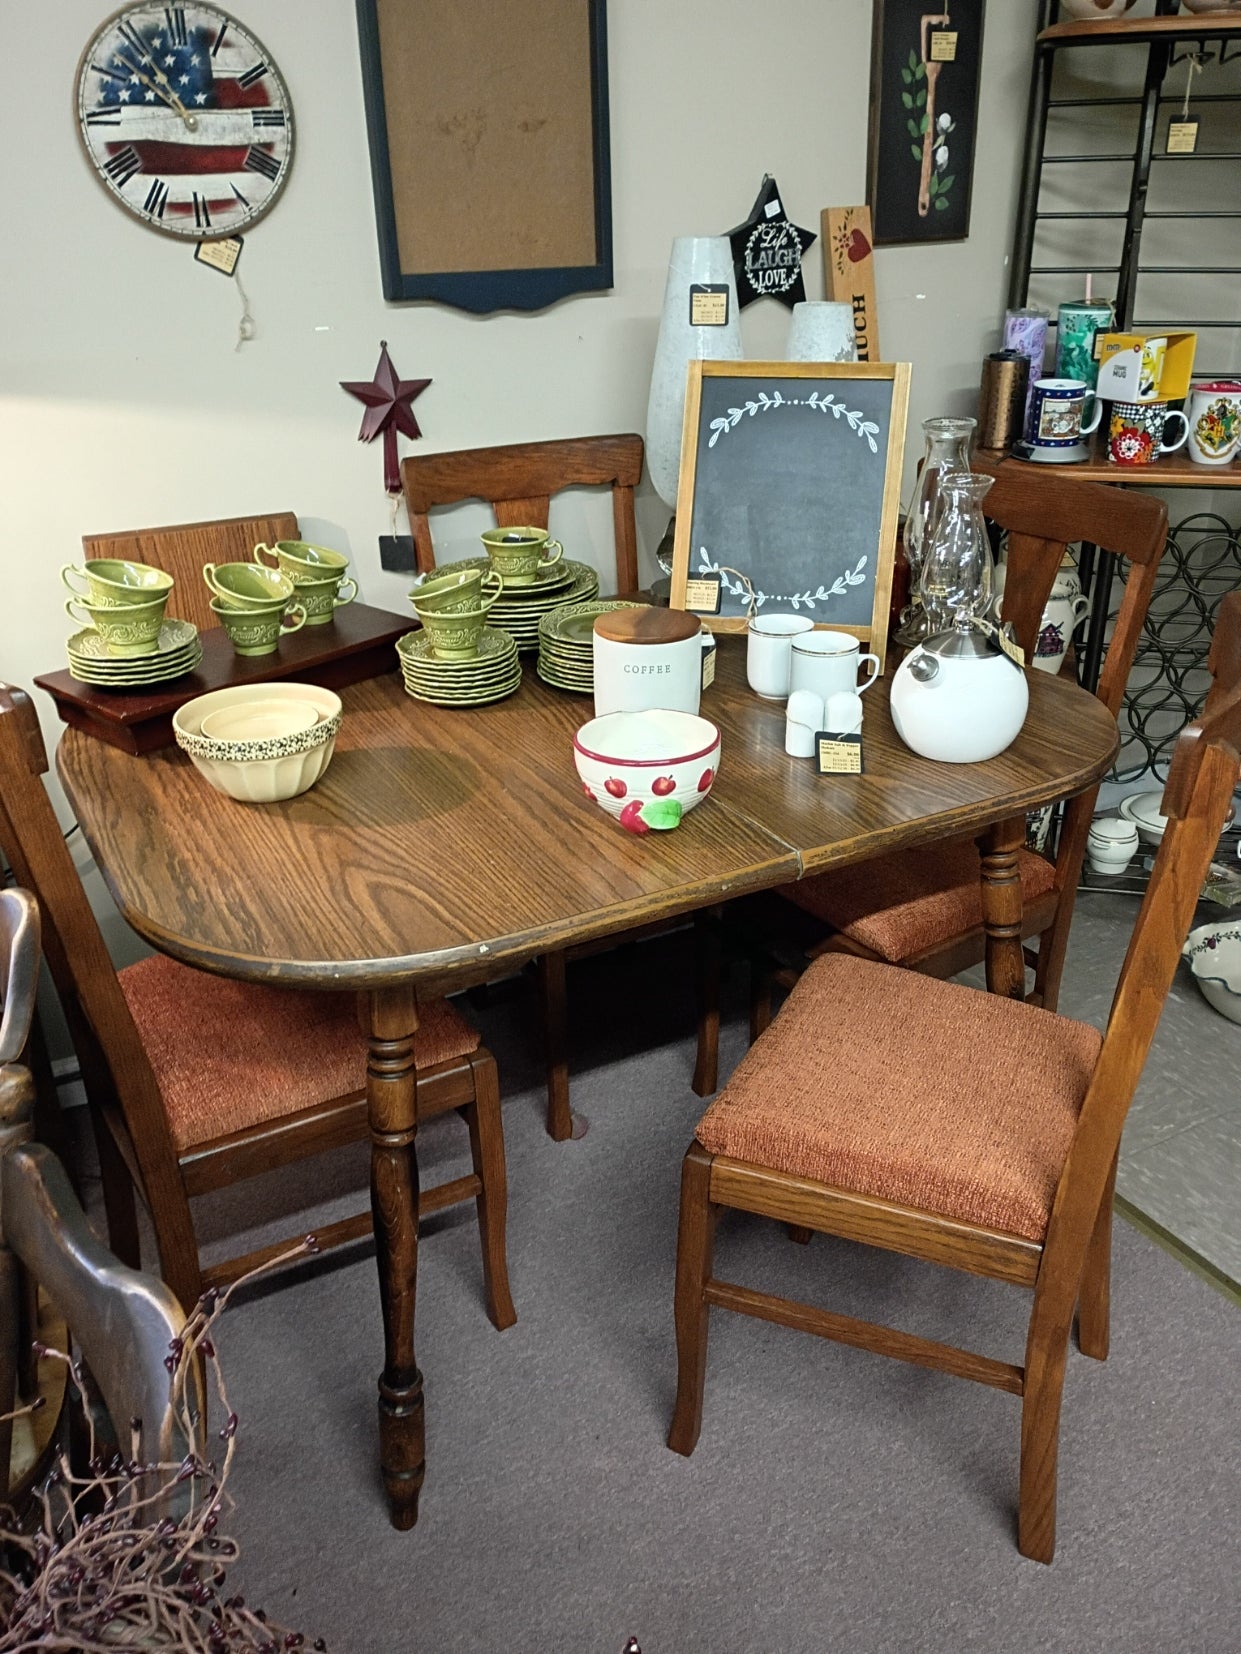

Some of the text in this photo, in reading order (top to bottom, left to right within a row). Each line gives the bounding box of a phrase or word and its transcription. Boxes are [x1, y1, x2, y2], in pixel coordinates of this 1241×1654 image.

[760, 228, 788, 251] Life
[749, 249, 800, 270] LAUGH
[759, 269, 787, 288] LOVE
[623, 664, 671, 674] COFFEE
